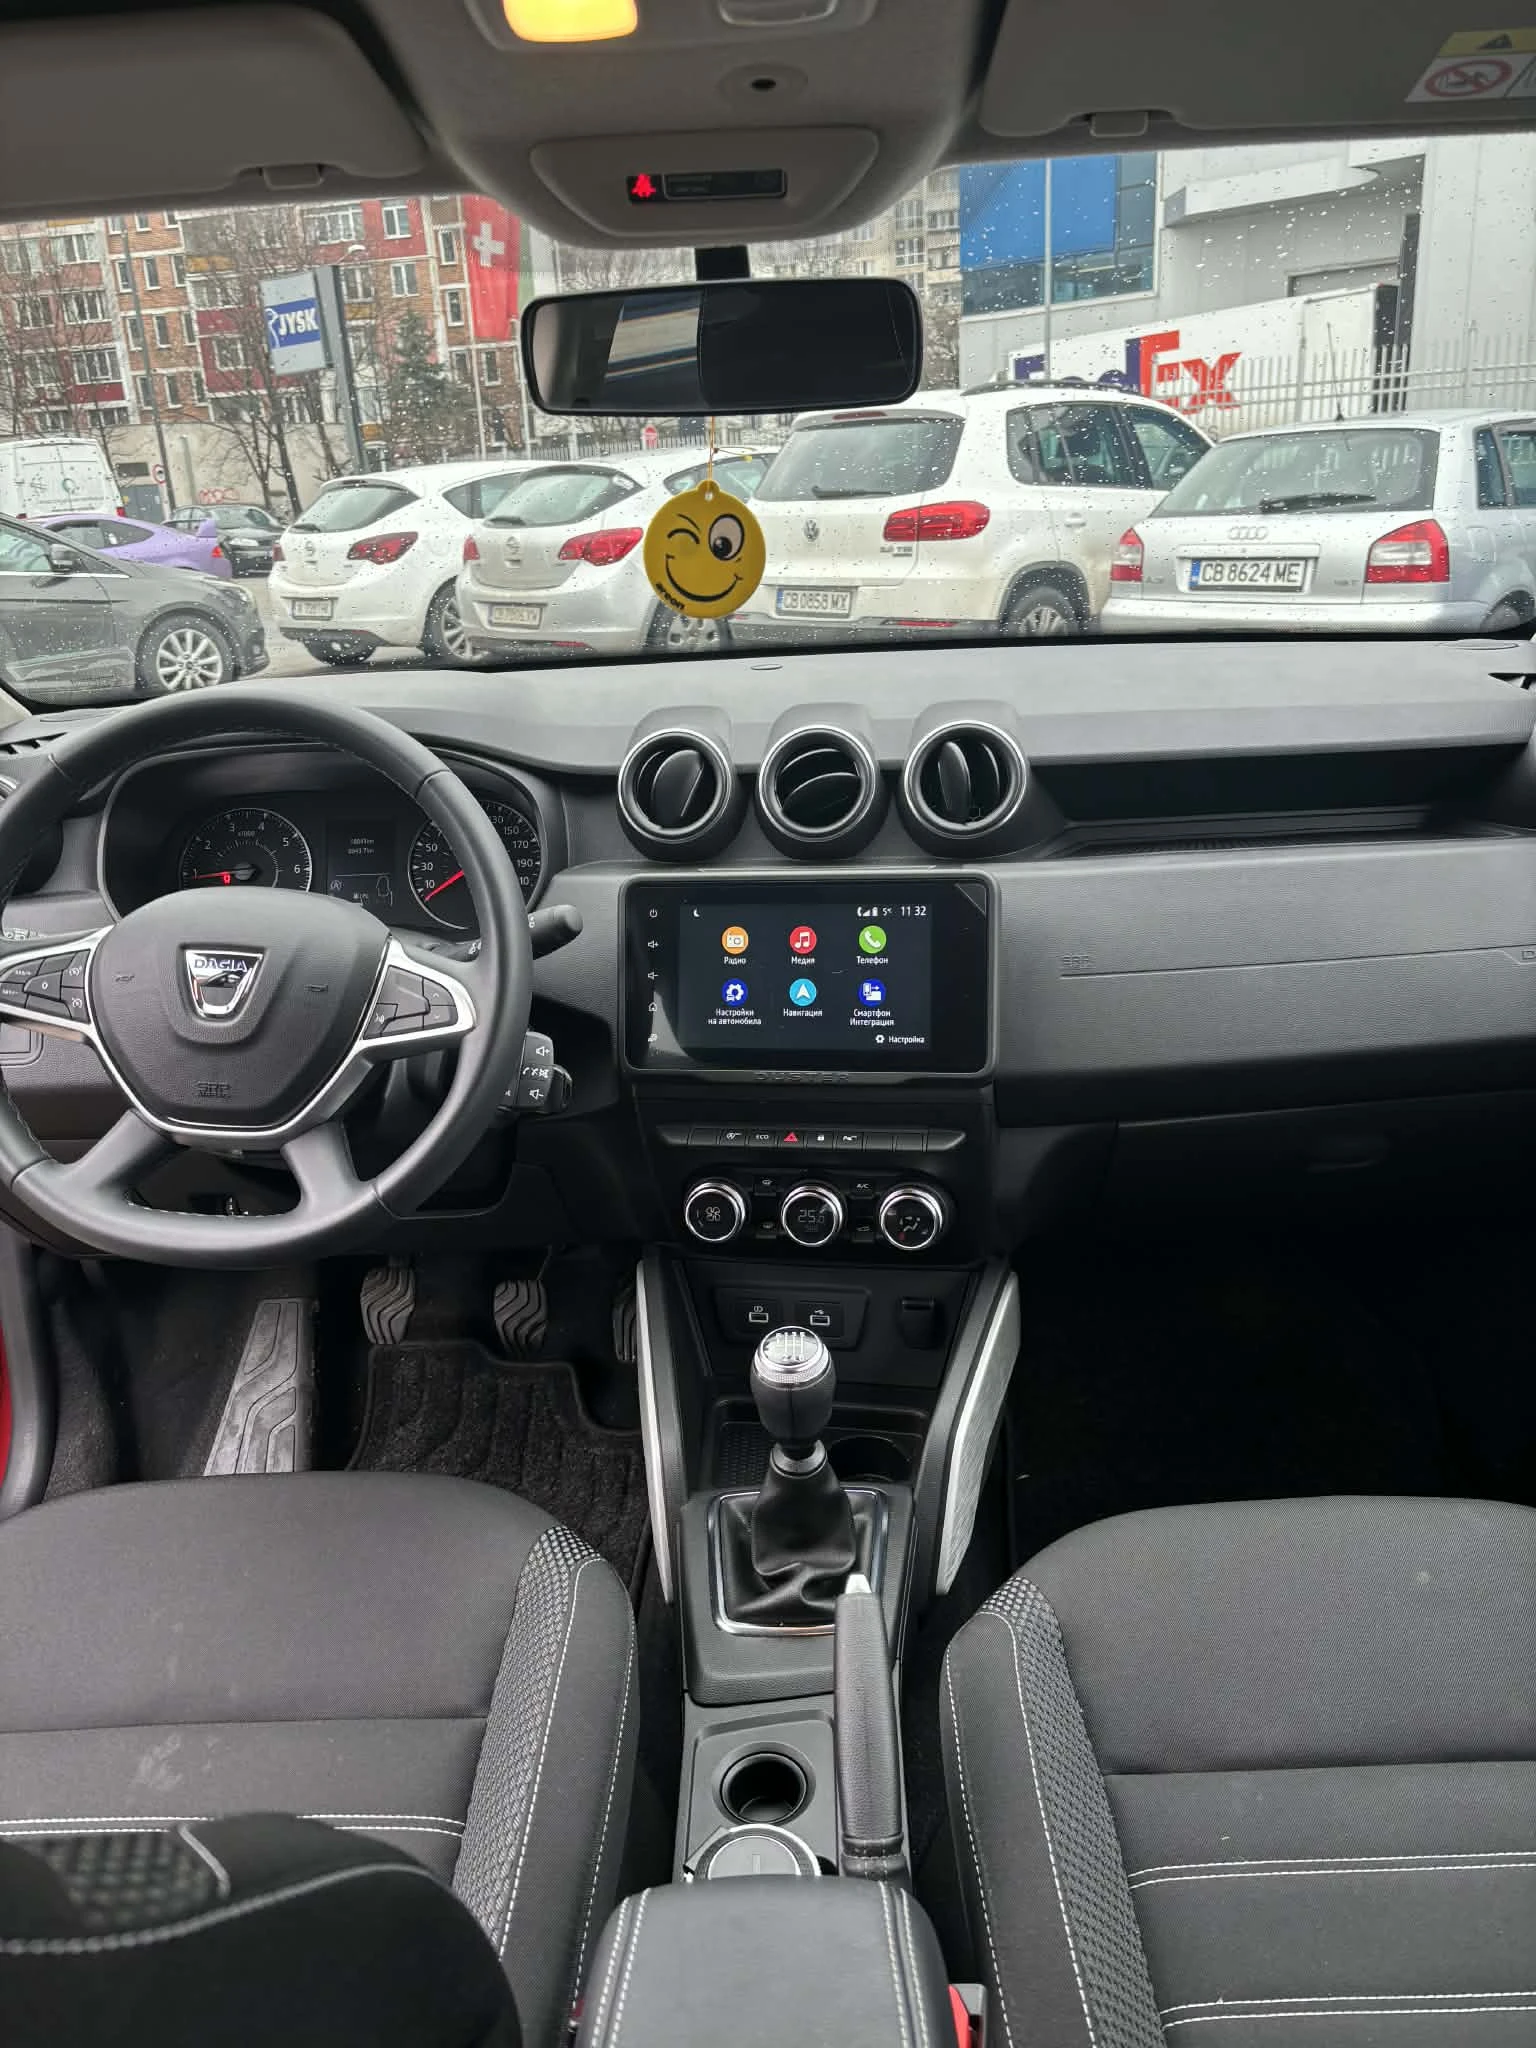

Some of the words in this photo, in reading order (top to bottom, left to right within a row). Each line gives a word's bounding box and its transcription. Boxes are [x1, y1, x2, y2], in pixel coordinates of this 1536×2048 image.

[278, 308, 320, 336] JYSK
[1014, 330, 1242, 416] dEx
[1202, 562, 1222, 582] CB
[1227, 562, 1271, 583] 8624
[1273, 563, 1299, 583] ME
[784, 592, 799, 609] CB
[204, 840, 212, 850] 2
[282, 837, 289, 847] 5
[512, 840, 529, 849] 170
[425, 843, 438, 852] 50
[293, 864, 301, 874] 6
[421, 862, 434, 871] 30
[424, 880, 436, 889] 10
[193, 958, 248, 972] DACIA
[723, 956, 747, 966] Радио
[856, 955, 889, 965] Телефон
[715, 1008, 755, 1017] Настройки
[783, 1008, 823, 1018] Навигация
[853, 1008, 891, 1018] Смартфон
